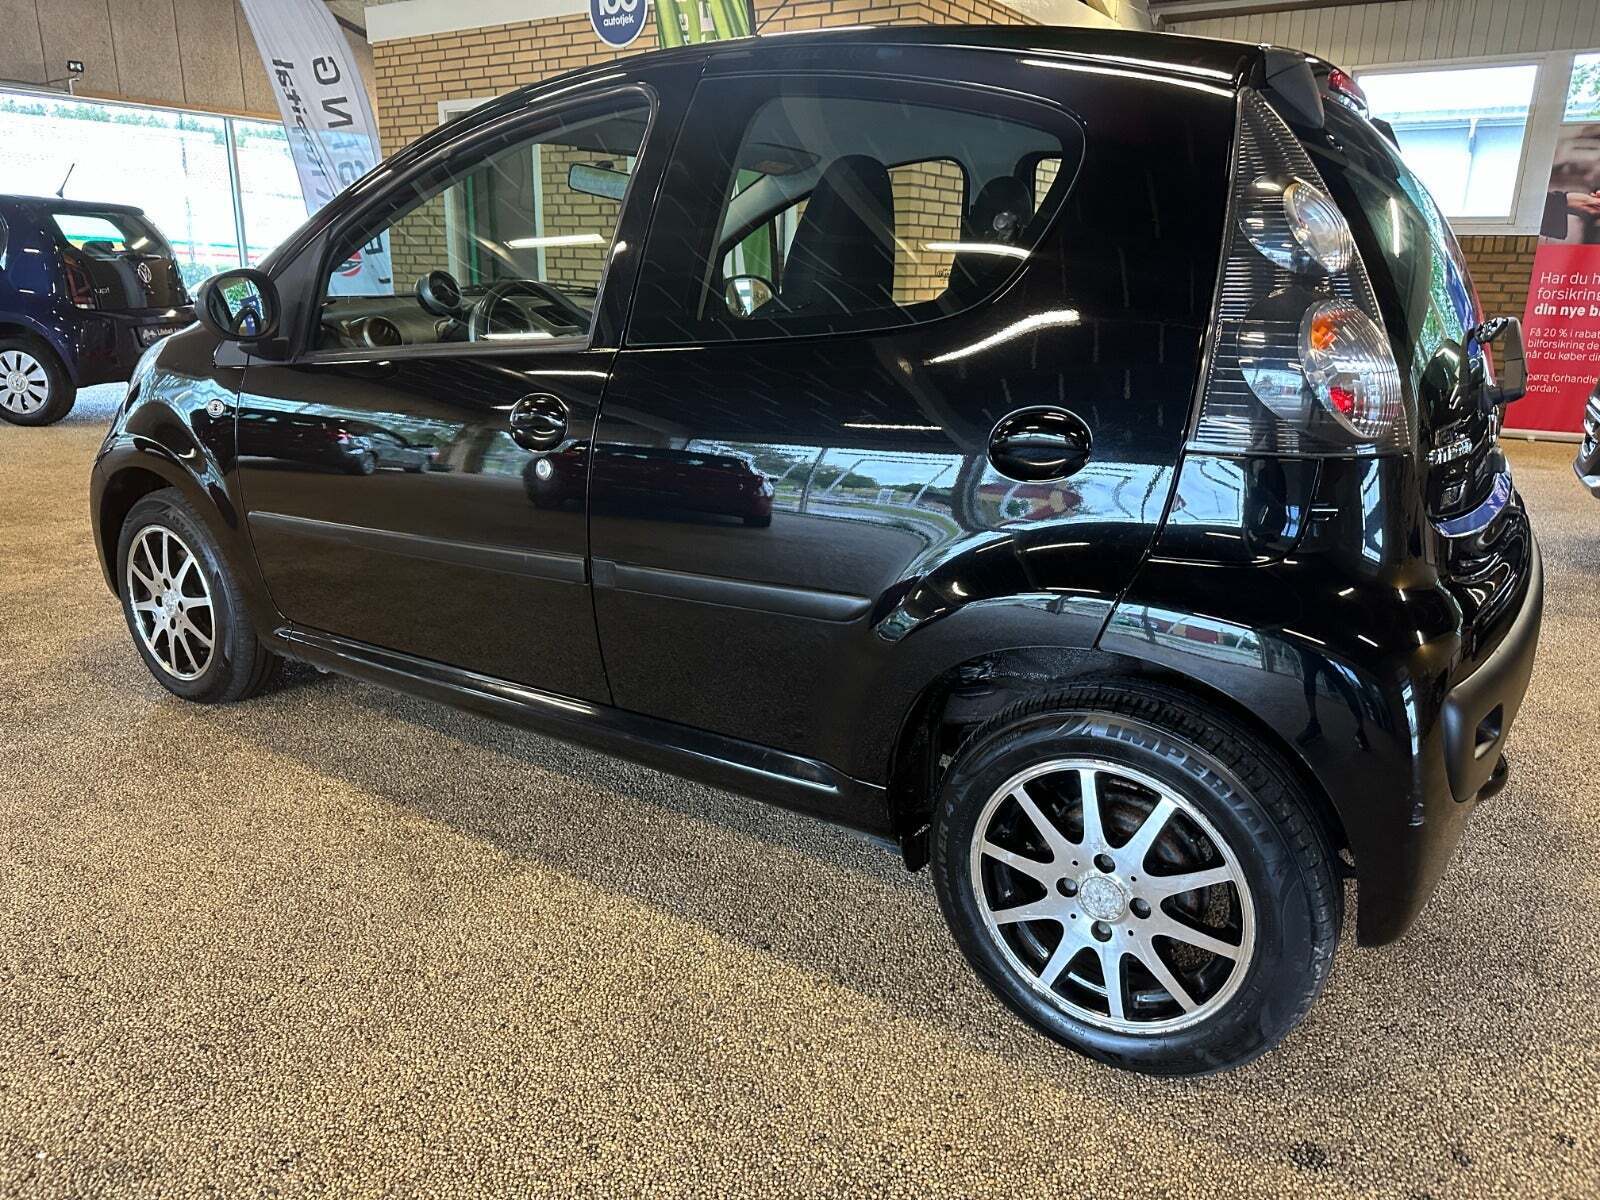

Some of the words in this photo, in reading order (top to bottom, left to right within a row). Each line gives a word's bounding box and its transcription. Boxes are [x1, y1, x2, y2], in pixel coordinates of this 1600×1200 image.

[1541, 272, 1567, 285] Har
[1569, 271, 1588, 285] du
[1534, 303, 1557, 315] din
[1560, 306, 1586, 319] nye
[1530, 327, 1541, 337] Få
[1543, 328, 1557, 337] 20
[1559, 328, 1568, 338] %
[1527, 338, 1586, 352] bilforsikring
[1525, 350, 1541, 359] når
[1543, 351, 1557, 360] du
[1558, 351, 1587, 361] køber
[1526, 373, 1550, 384] pørg
[1551, 373, 1598, 385] forhandle
[1525, 384, 1560, 393] vordan.
[1104, 724, 1276, 848] IMPERIAL
